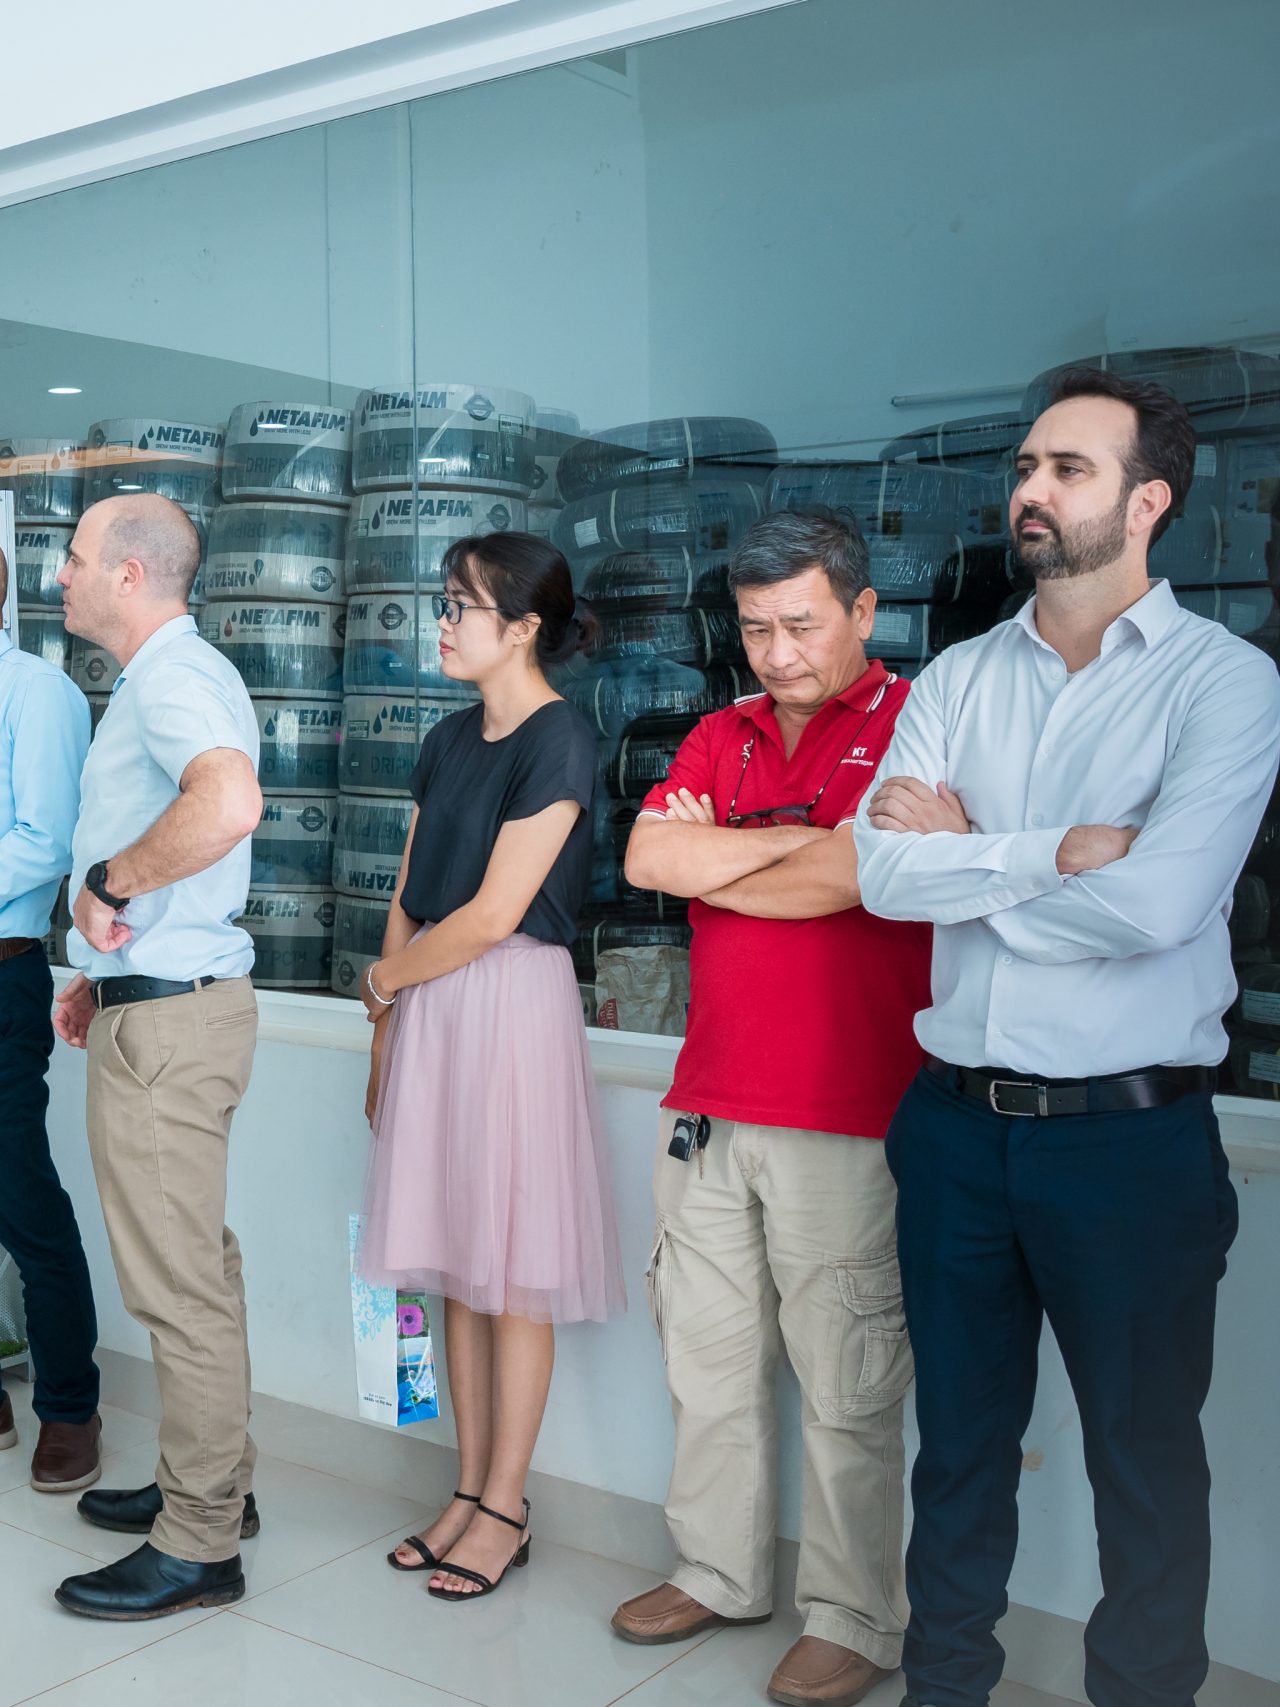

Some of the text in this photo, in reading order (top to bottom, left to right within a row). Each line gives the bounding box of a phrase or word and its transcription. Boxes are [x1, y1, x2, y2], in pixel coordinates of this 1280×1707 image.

[265, 409, 346, 432] NETAFIM
[239, 608, 320, 628] NETAFIM
[852, 746, 868, 757] KT
